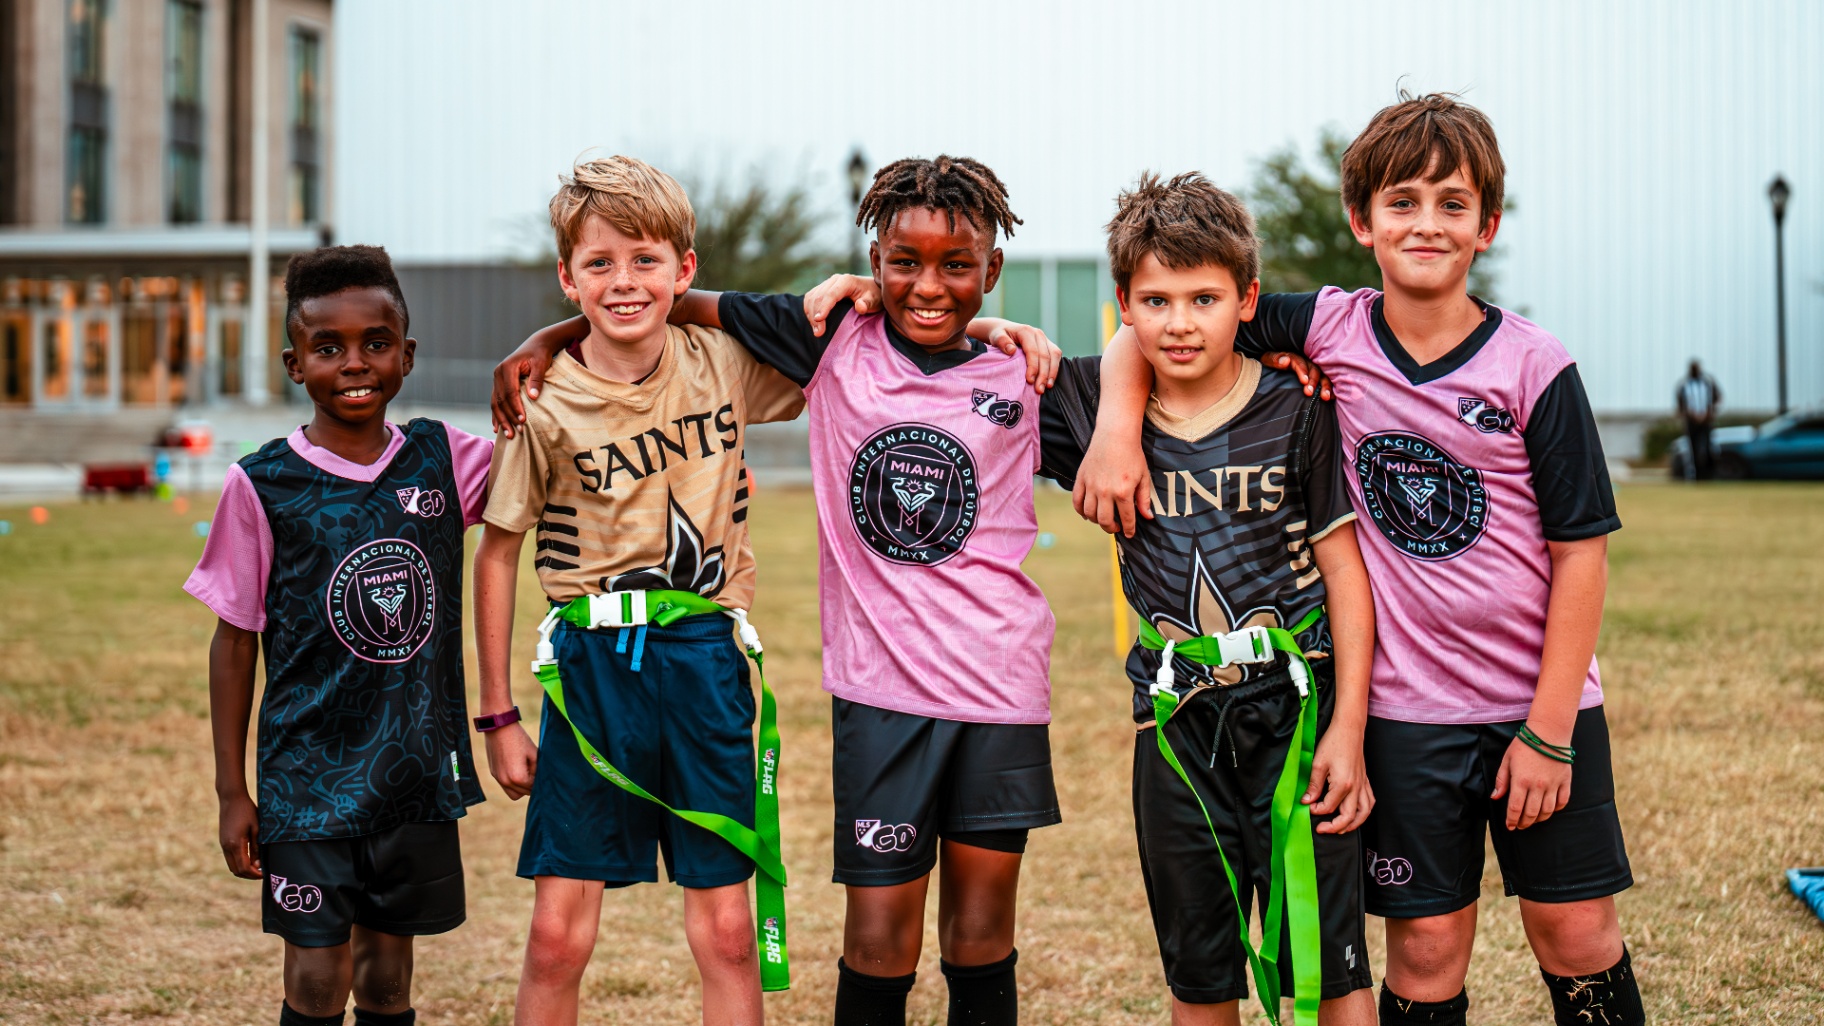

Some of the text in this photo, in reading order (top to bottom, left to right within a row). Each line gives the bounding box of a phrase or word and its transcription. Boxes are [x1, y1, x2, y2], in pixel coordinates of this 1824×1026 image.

[988, 399, 1024, 430] GO
[573, 403, 738, 494] SAINTS
[890, 460, 945, 480] MIAMI
[1386, 461, 1439, 473] MIAMI
[853, 430, 976, 543] CLUB INTERNACIONAL DE FÚTBOL
[1149, 465, 1286, 518] INTS
[1364, 482, 1384, 520] CLUB
[416, 489, 446, 518] GO
[888, 544, 930, 560] MMXX
[1407, 540, 1450, 554] MMXX
[333, 544, 416, 603] INTERNACIONAL
[363, 569, 408, 586] MIAMI
[418, 560, 428, 576] DE
[334, 610, 355, 640] CLUB
[377, 644, 412, 657] MMXX
[763, 757, 775, 795] FLAG
[293, 804, 333, 836] #1
[872, 823, 917, 853] GO
[1375, 857, 1413, 886] GO
[281, 884, 322, 913] GO
[763, 925, 782, 964] FLAG
